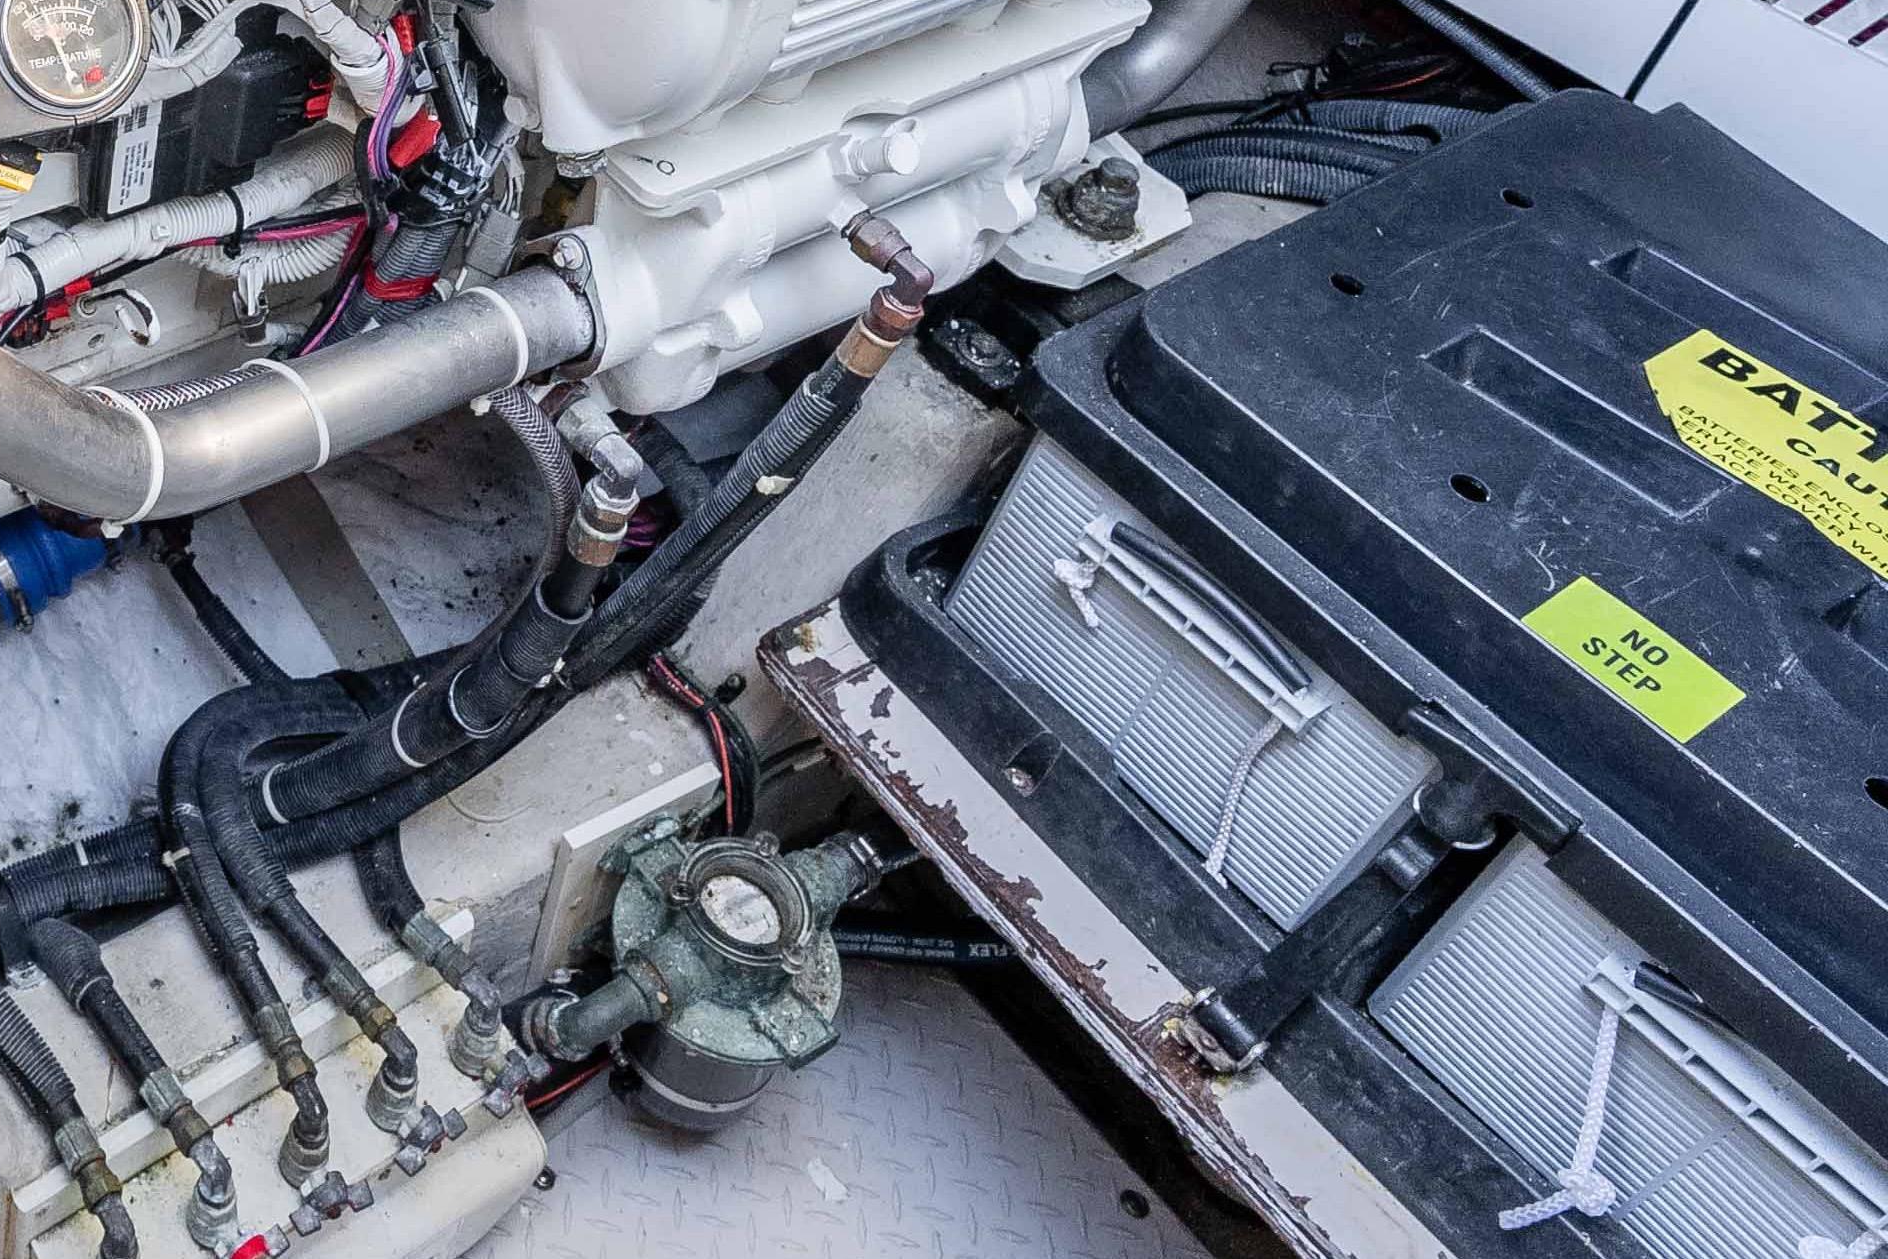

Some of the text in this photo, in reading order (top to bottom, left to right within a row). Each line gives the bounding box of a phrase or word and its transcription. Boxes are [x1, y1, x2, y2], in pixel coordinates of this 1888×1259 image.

[1678, 405, 1801, 479] BATTERIES
[1678, 414, 1862, 532] ERVICE WEEKLY
[1765, 483, 1845, 538] COVER
[1581, 636, 1662, 692] STEP
[1620, 629, 1669, 666] NO
